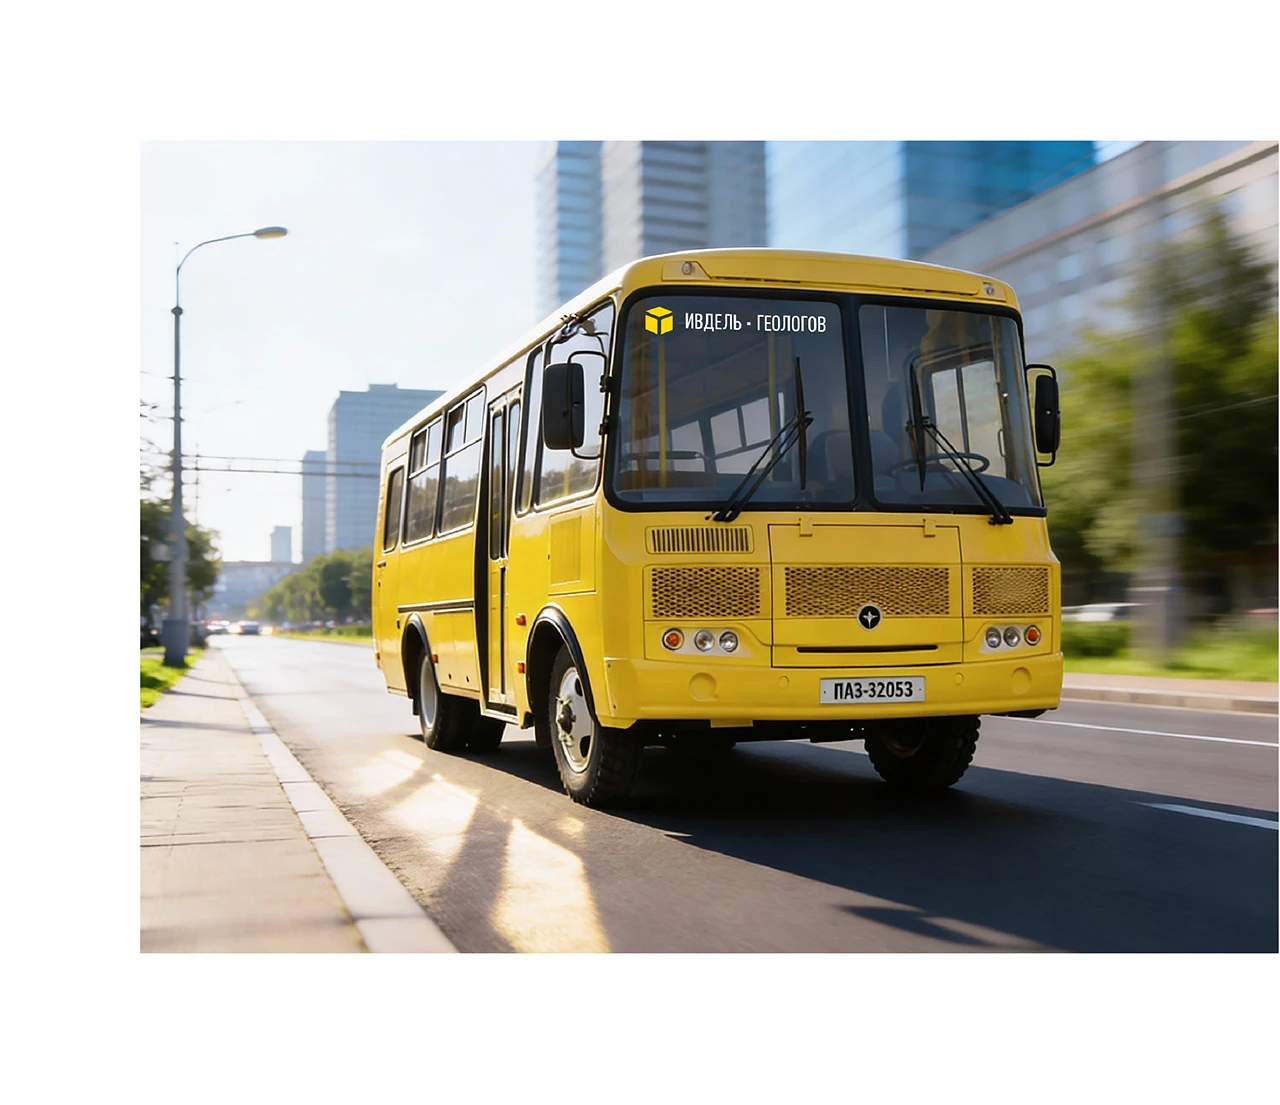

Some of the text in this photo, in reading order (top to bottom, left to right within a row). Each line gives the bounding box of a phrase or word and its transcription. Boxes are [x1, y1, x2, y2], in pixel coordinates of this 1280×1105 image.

[685, 312, 742, 332] ИВДЕЛЬ
[757, 314, 827, 333] ГЕОЛОГОВ
[834, 681, 913, 700] ПАЗ-32053
